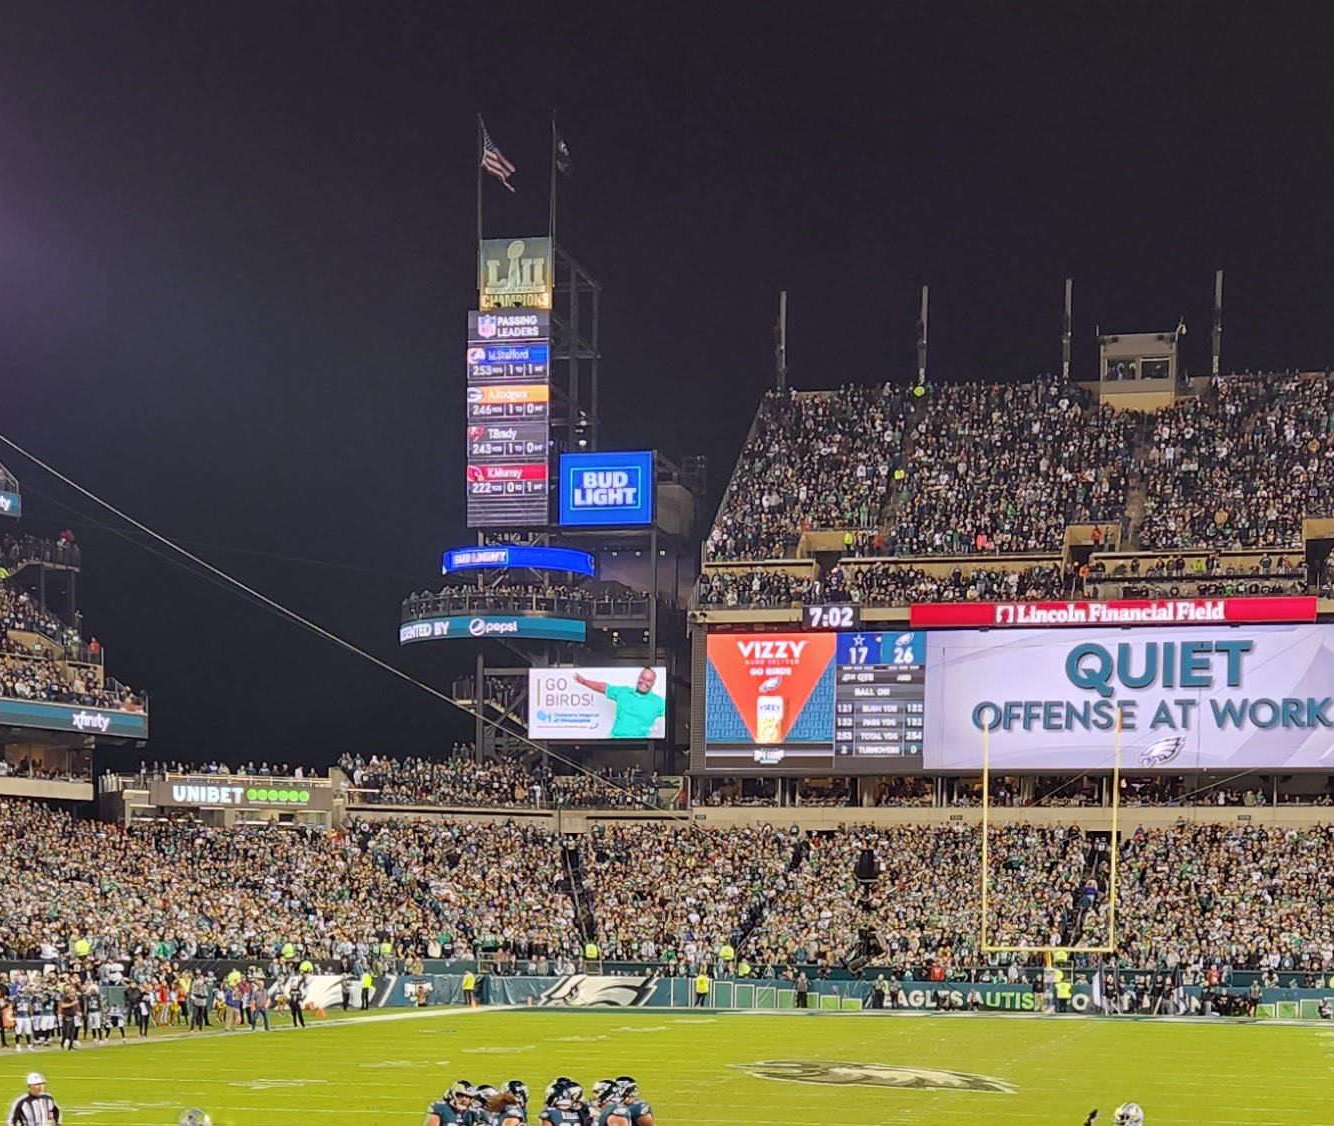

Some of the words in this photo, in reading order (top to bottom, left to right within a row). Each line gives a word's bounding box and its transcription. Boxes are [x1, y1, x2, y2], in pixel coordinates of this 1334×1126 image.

[481, 293, 549, 307] CHAMPIONS
[497, 315, 537, 325] PASSING
[497, 327, 539, 337] LEADERS
[508, 364, 514, 375] 1
[472, 405, 492, 415] 246
[508, 404, 514, 414] 1
[472, 443, 492, 454] 243
[508, 443, 513, 453] 1
[583, 471, 629, 489] BUD
[472, 483, 492, 493] 222
[574, 488, 637, 506] LIGHT
[809, 607, 854, 628] 7:02
[1017, 603, 1087, 624] Lincoln
[1089, 602, 1175, 622] Financial
[1177, 600, 1225, 622] Field
[434, 621, 450, 636] BY
[736, 640, 806, 659] VIZZY
[849, 647, 869, 664] 17
[893, 647, 915, 664] 26
[749, 667, 764, 676] GO
[765, 667, 792, 676] BIRDS
[1065, 638, 1254, 697] QUIET
[545, 677, 568, 691] GO
[854, 687, 875, 696] BALL
[876, 687, 891, 696] ON
[545, 694, 595, 707] BIRDS!
[971, 698, 1137, 731] OFFENSE
[1150, 698, 1204, 730] AT
[1209, 696, 1334, 729] WORK
[72, 711, 110, 732] xfinity
[910, 745, 918, 755] 0
[172, 785, 245, 804] UNIBET
